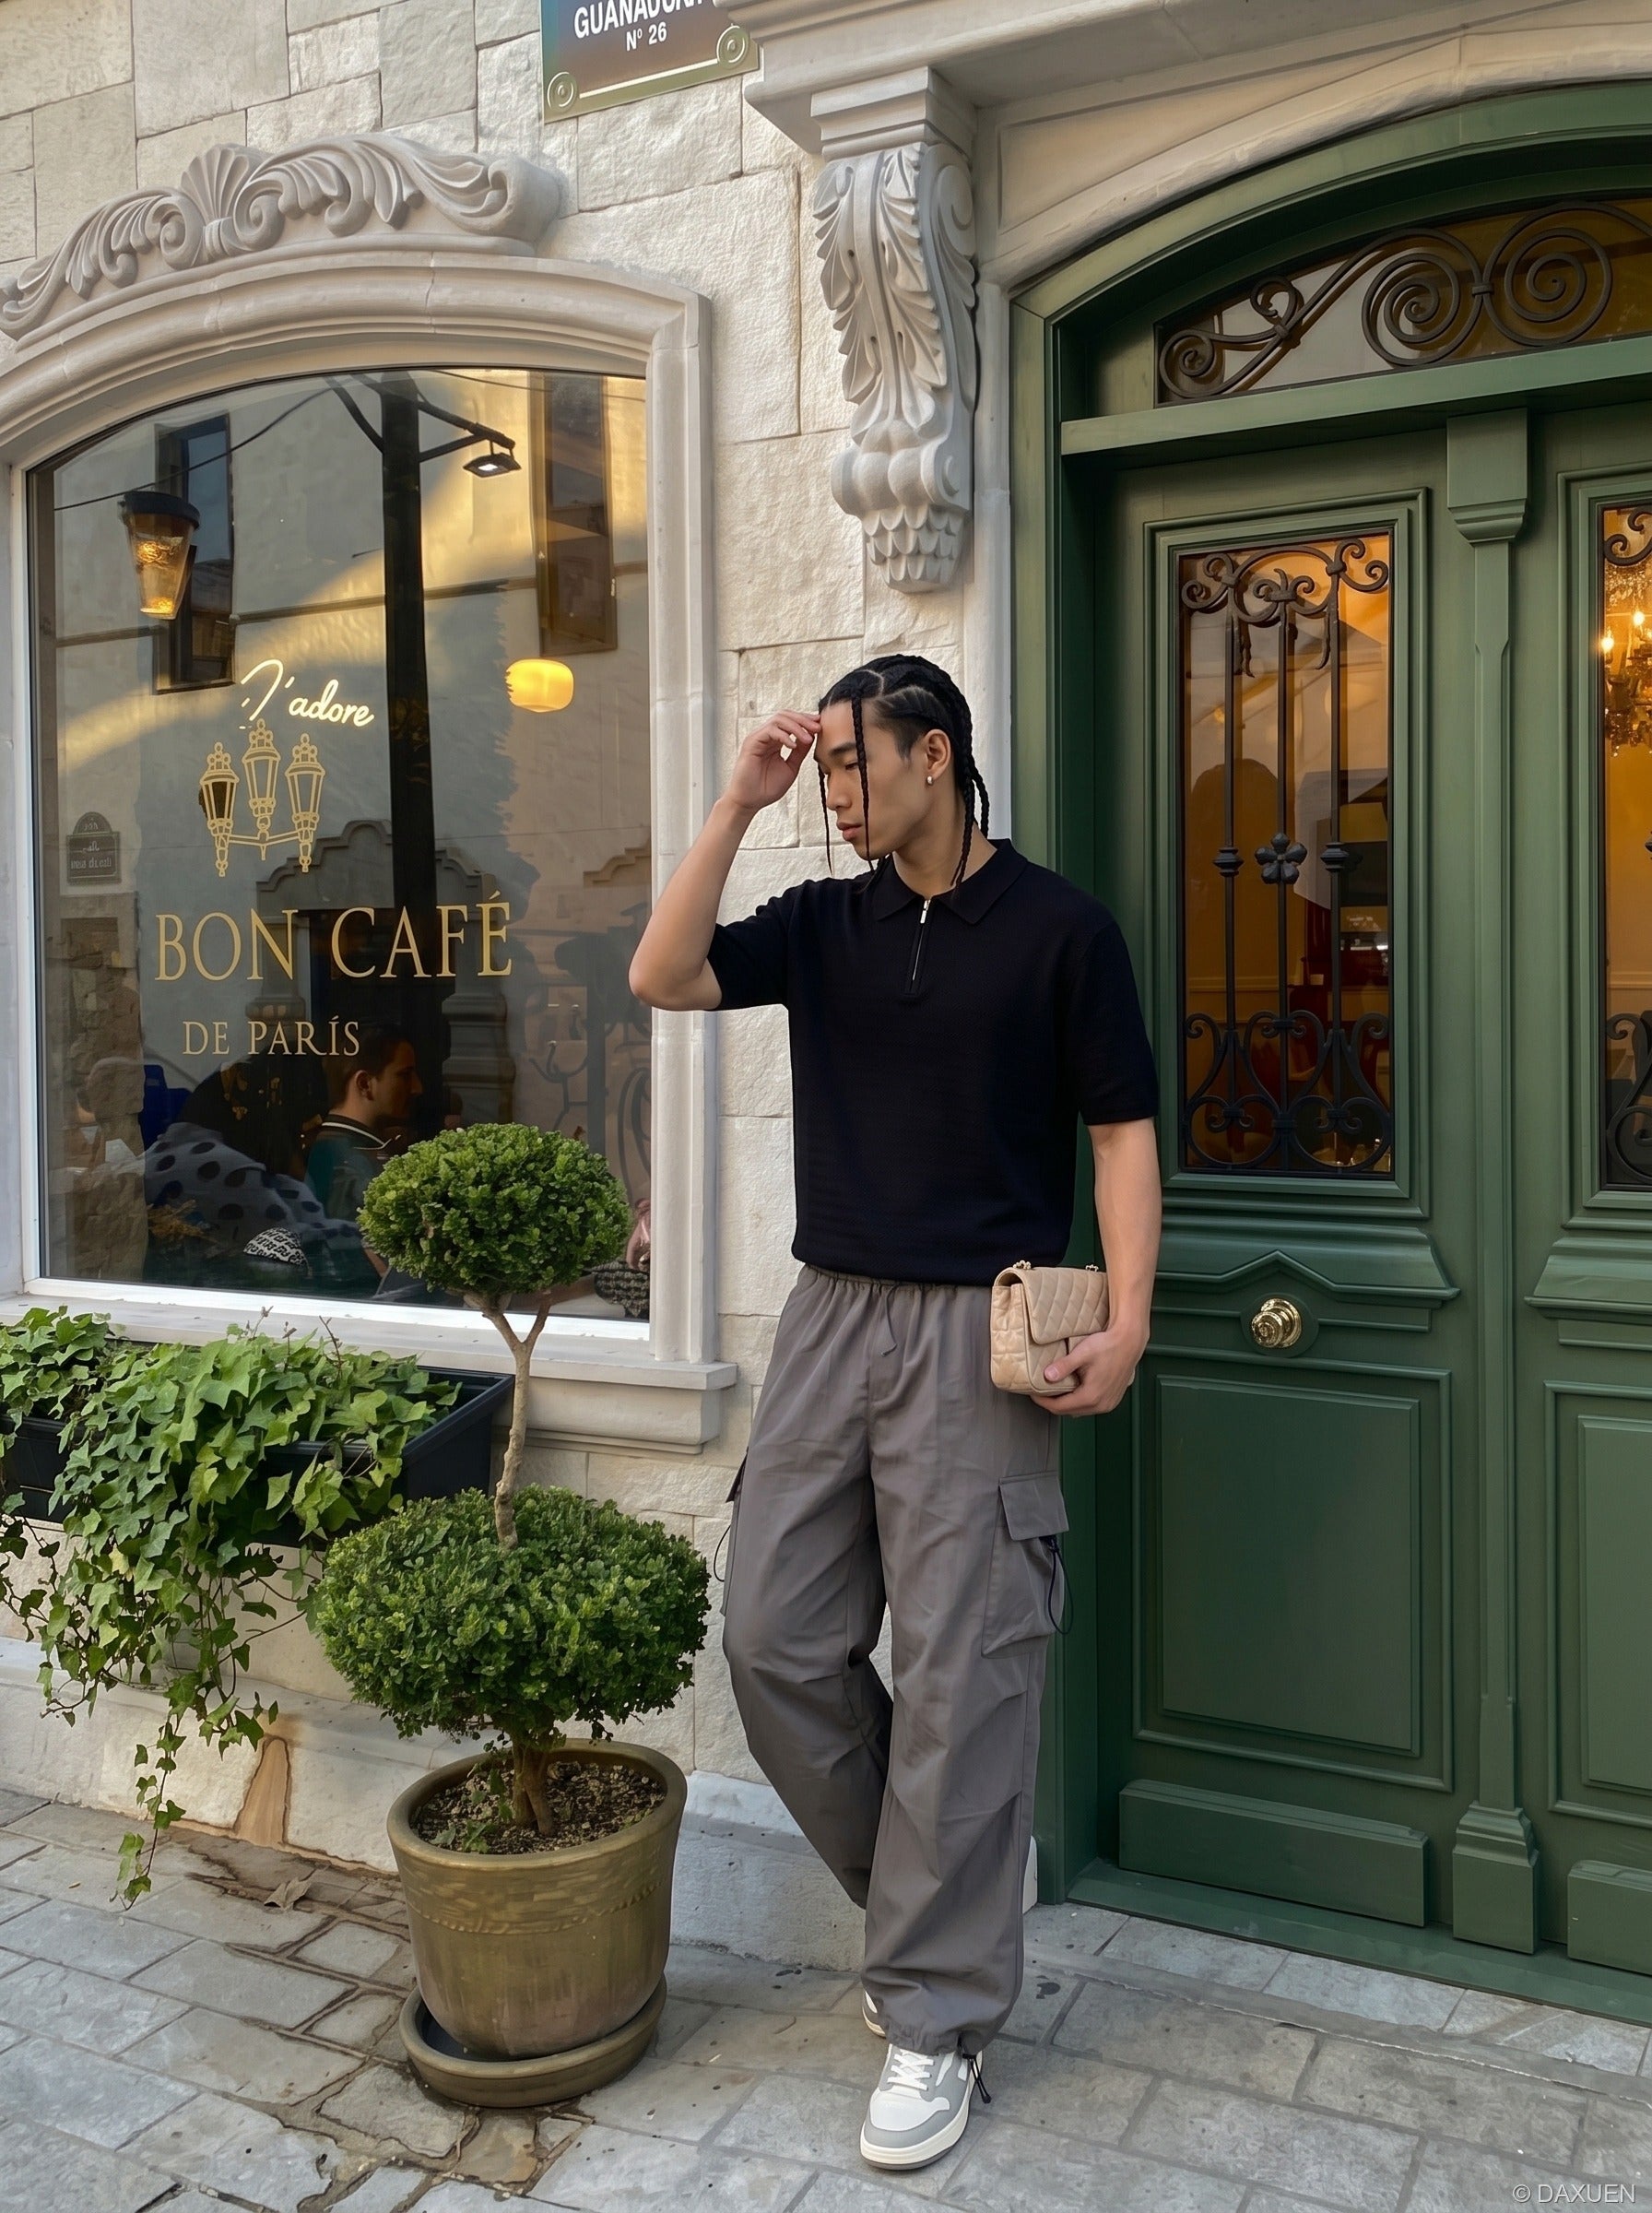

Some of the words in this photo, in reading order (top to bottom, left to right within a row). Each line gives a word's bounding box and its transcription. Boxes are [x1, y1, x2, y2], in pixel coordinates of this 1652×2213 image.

[648, 21, 667, 44] 26
[155, 907, 299, 981] BON
[330, 891, 513, 978] CAFÉ
[183, 1021, 230, 1056] DE
[248, 1015, 360, 1057] PARÍS
